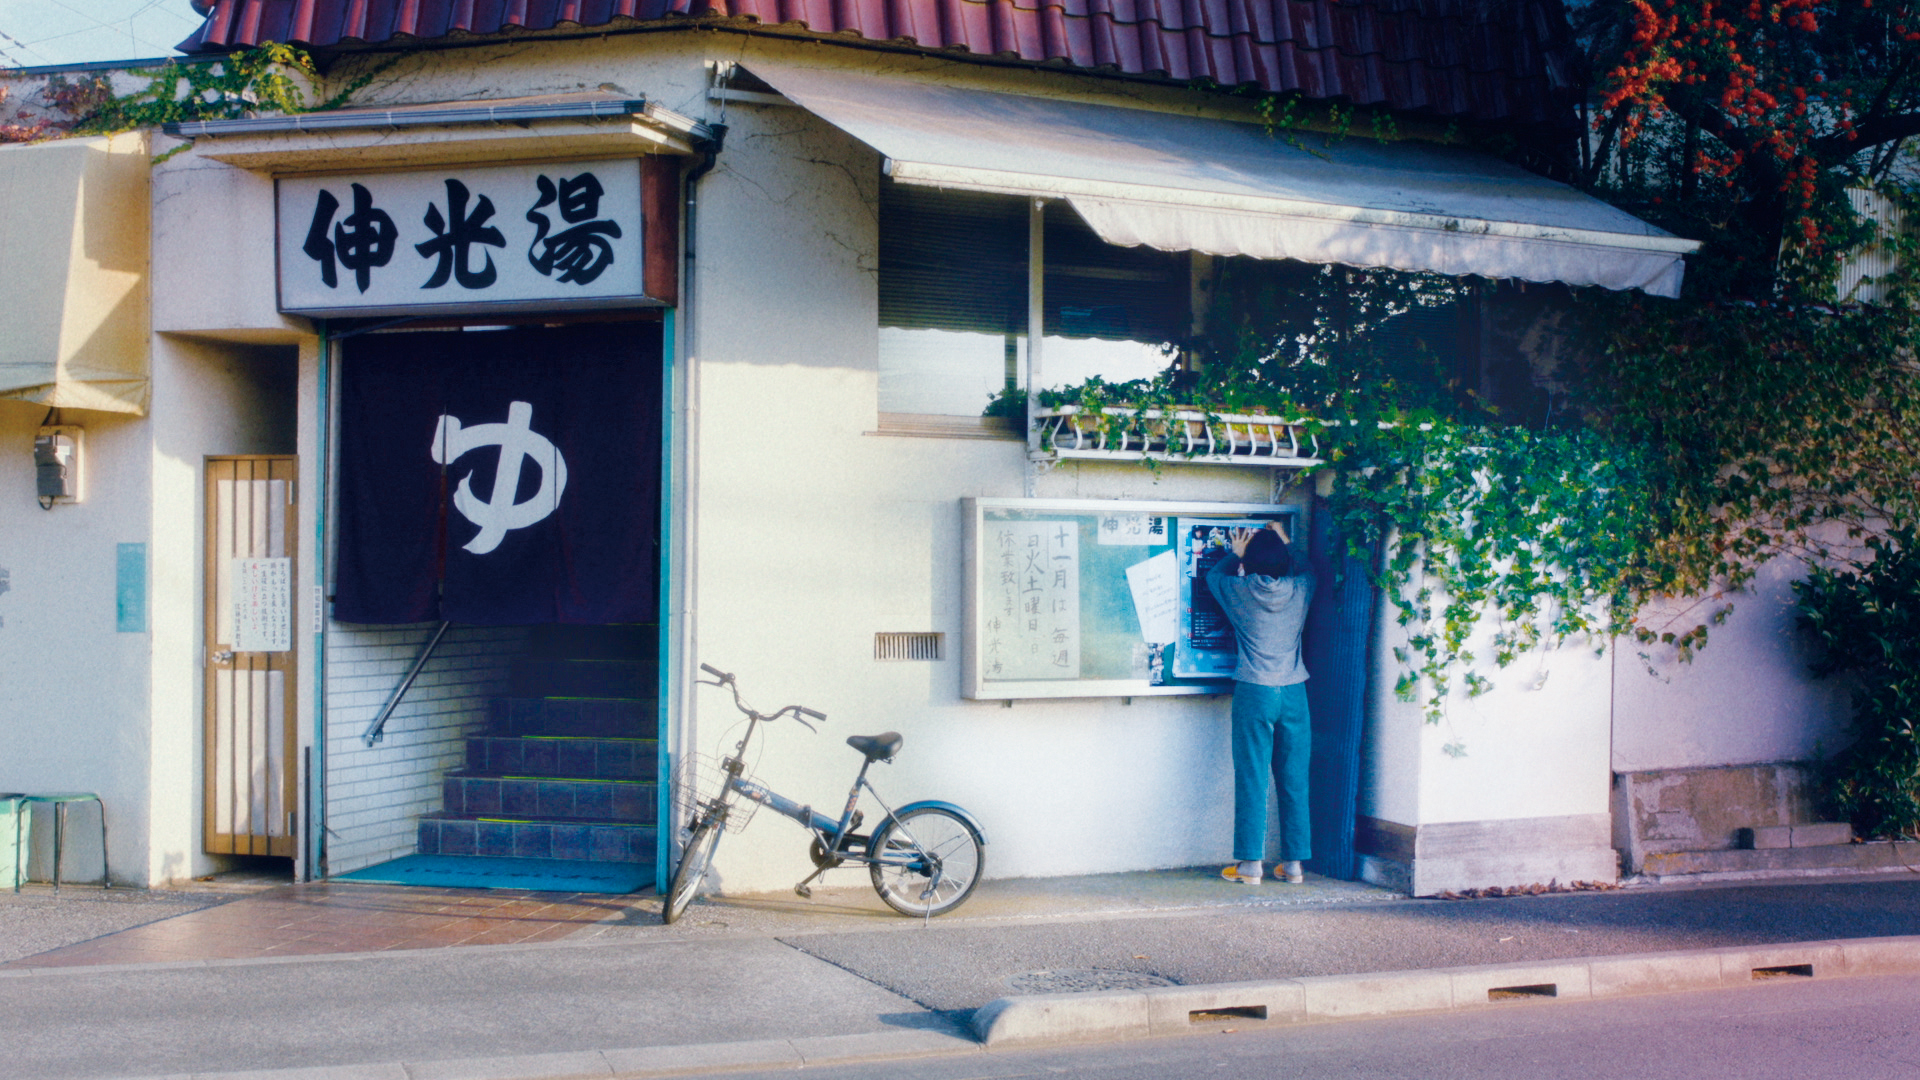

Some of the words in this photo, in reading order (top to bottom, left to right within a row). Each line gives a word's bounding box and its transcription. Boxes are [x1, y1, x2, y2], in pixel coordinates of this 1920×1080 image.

[302, 172, 622, 294] 伸光湯
[431, 401, 567, 554] ゆ
[996, 529, 1017, 617] 休業致します
